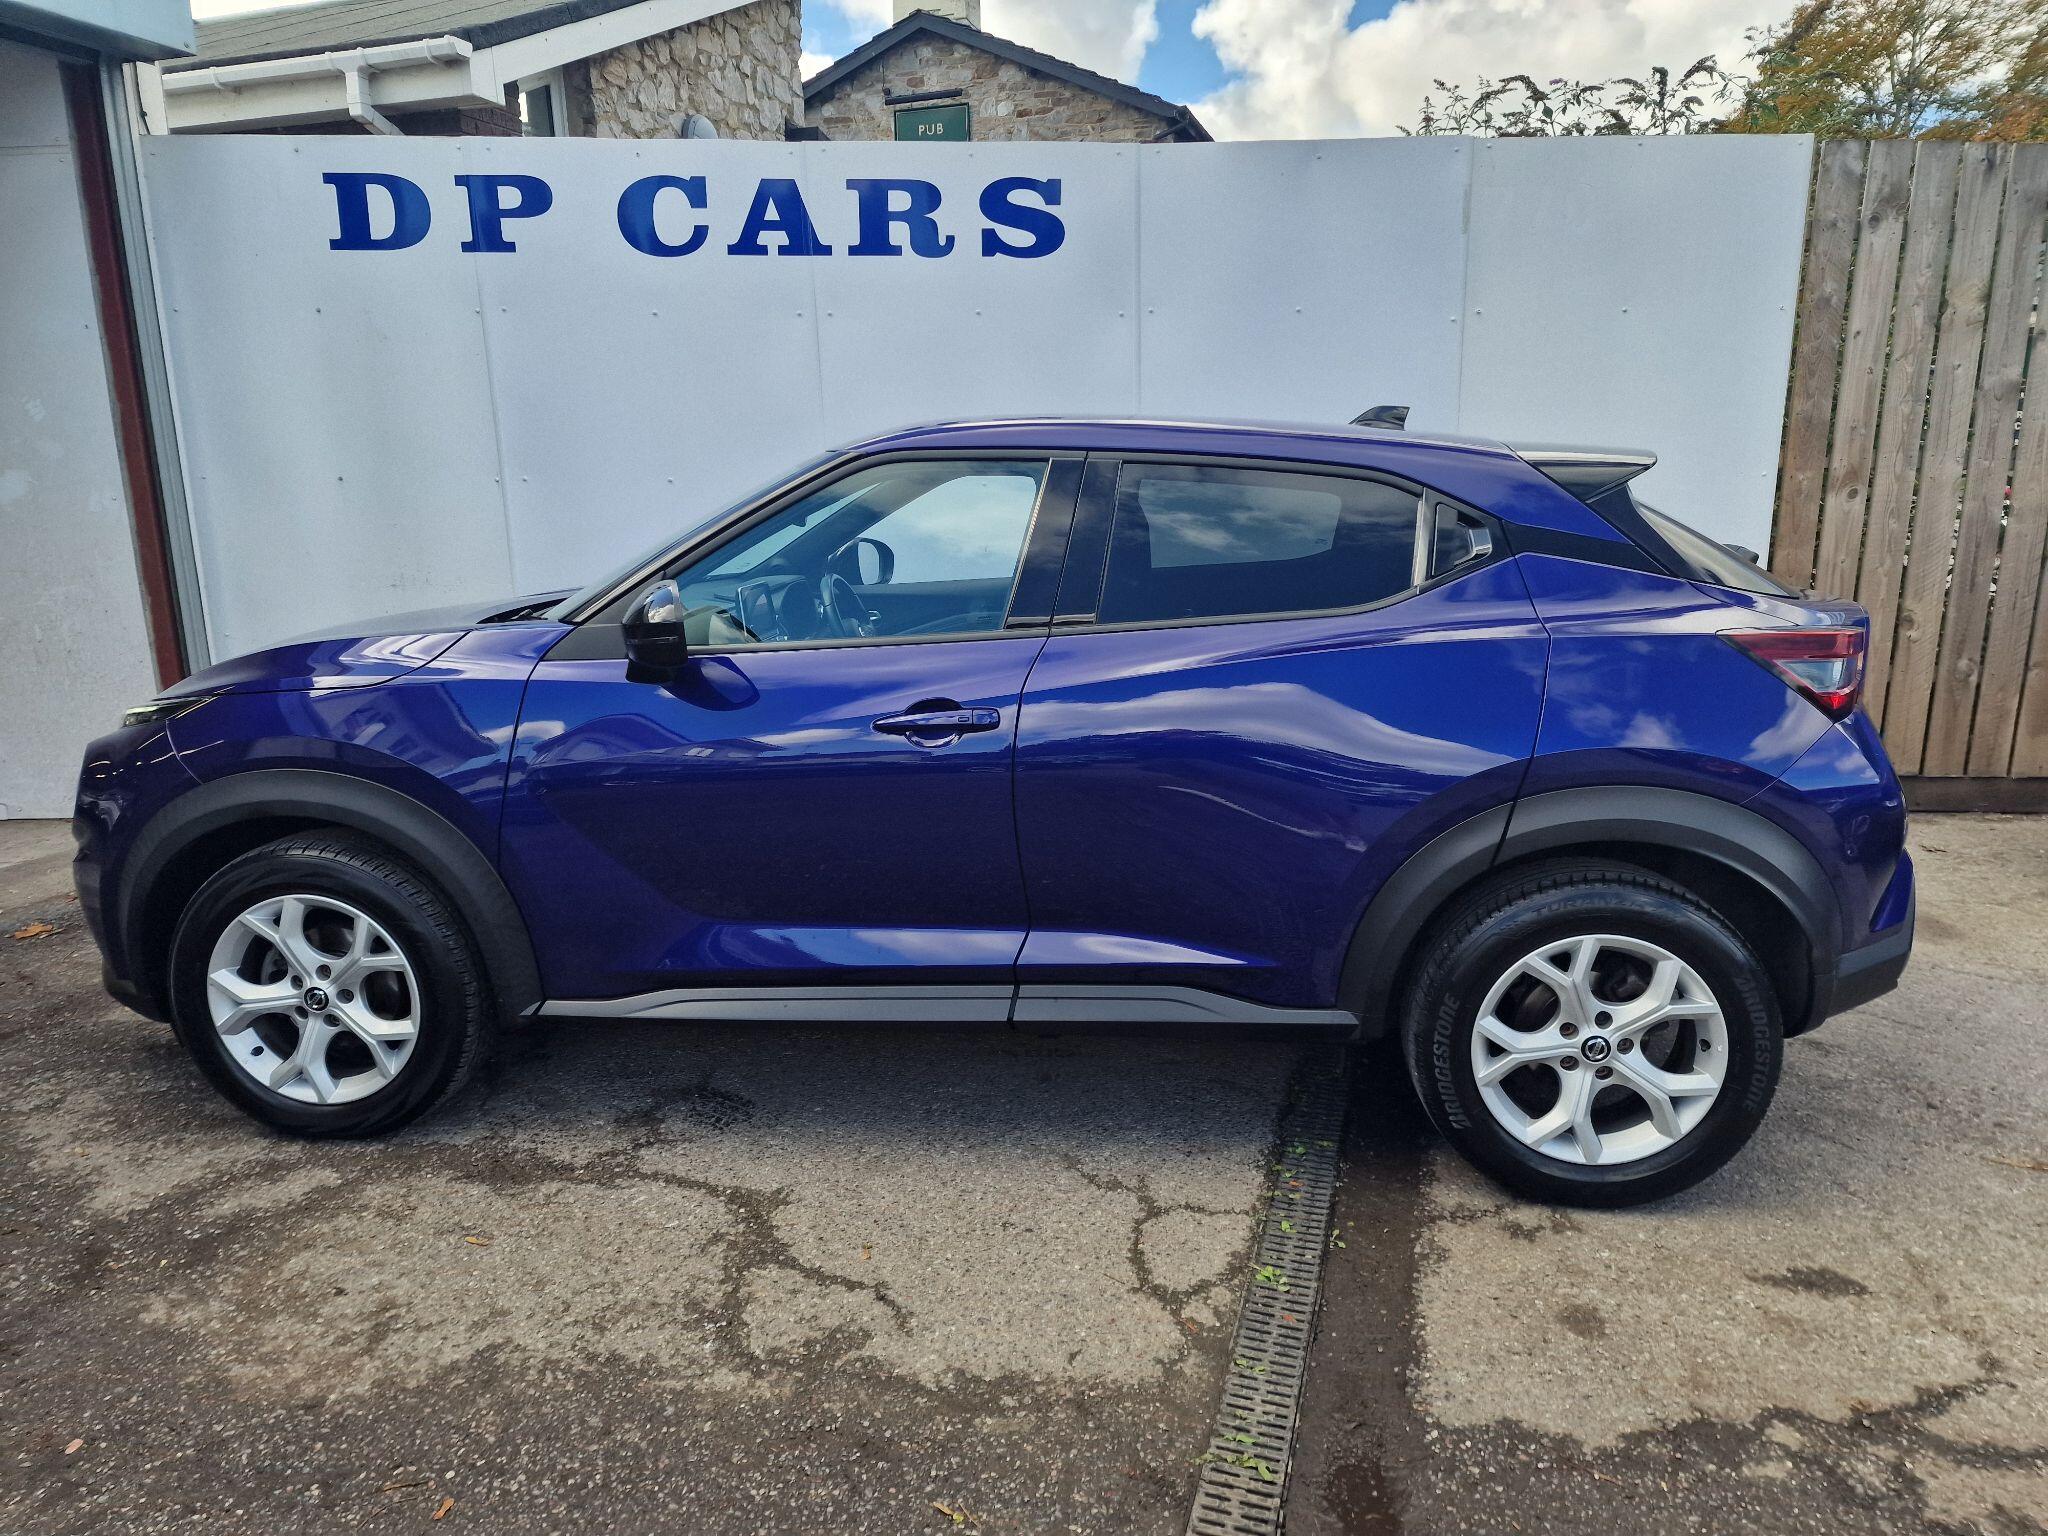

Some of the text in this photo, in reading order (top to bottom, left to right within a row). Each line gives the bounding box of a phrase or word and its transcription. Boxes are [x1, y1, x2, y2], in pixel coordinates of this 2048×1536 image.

[918, 123, 944, 136] PUB
[322, 172, 1066, 258] DP CARS
[1433, 992, 1472, 1130] BRIDGESTONE
[1734, 976, 1771, 1114] BRIDGESTONE
